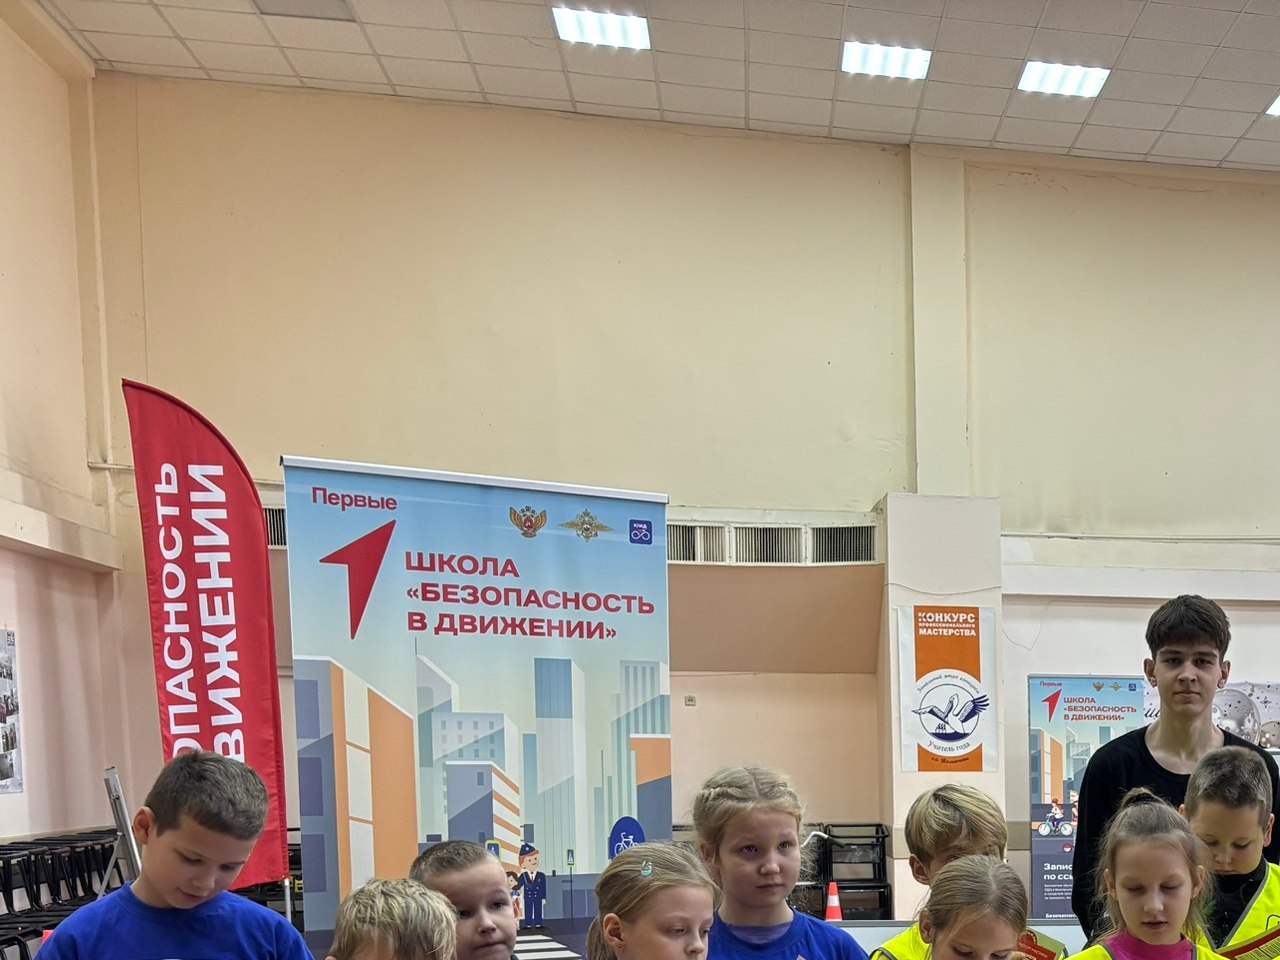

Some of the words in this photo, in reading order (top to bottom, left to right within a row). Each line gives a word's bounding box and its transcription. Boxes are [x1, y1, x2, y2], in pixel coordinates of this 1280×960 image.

[312, 487, 398, 512] Первые
[405, 551, 520, 578] ШКОЛА
[154, 463, 202, 759] ОПАСНОСТЬ
[406, 582, 655, 615] «БЕЗОПАСНОСТЬ
[187, 464, 246, 764] ВИЖЕНИИ
[407, 612, 427, 632] В
[434, 613, 617, 640] ДВИЖЕНИИ»
[918, 612, 976, 622] КОНКУРС
[919, 628, 976, 636] МАСТЕРСТВА
